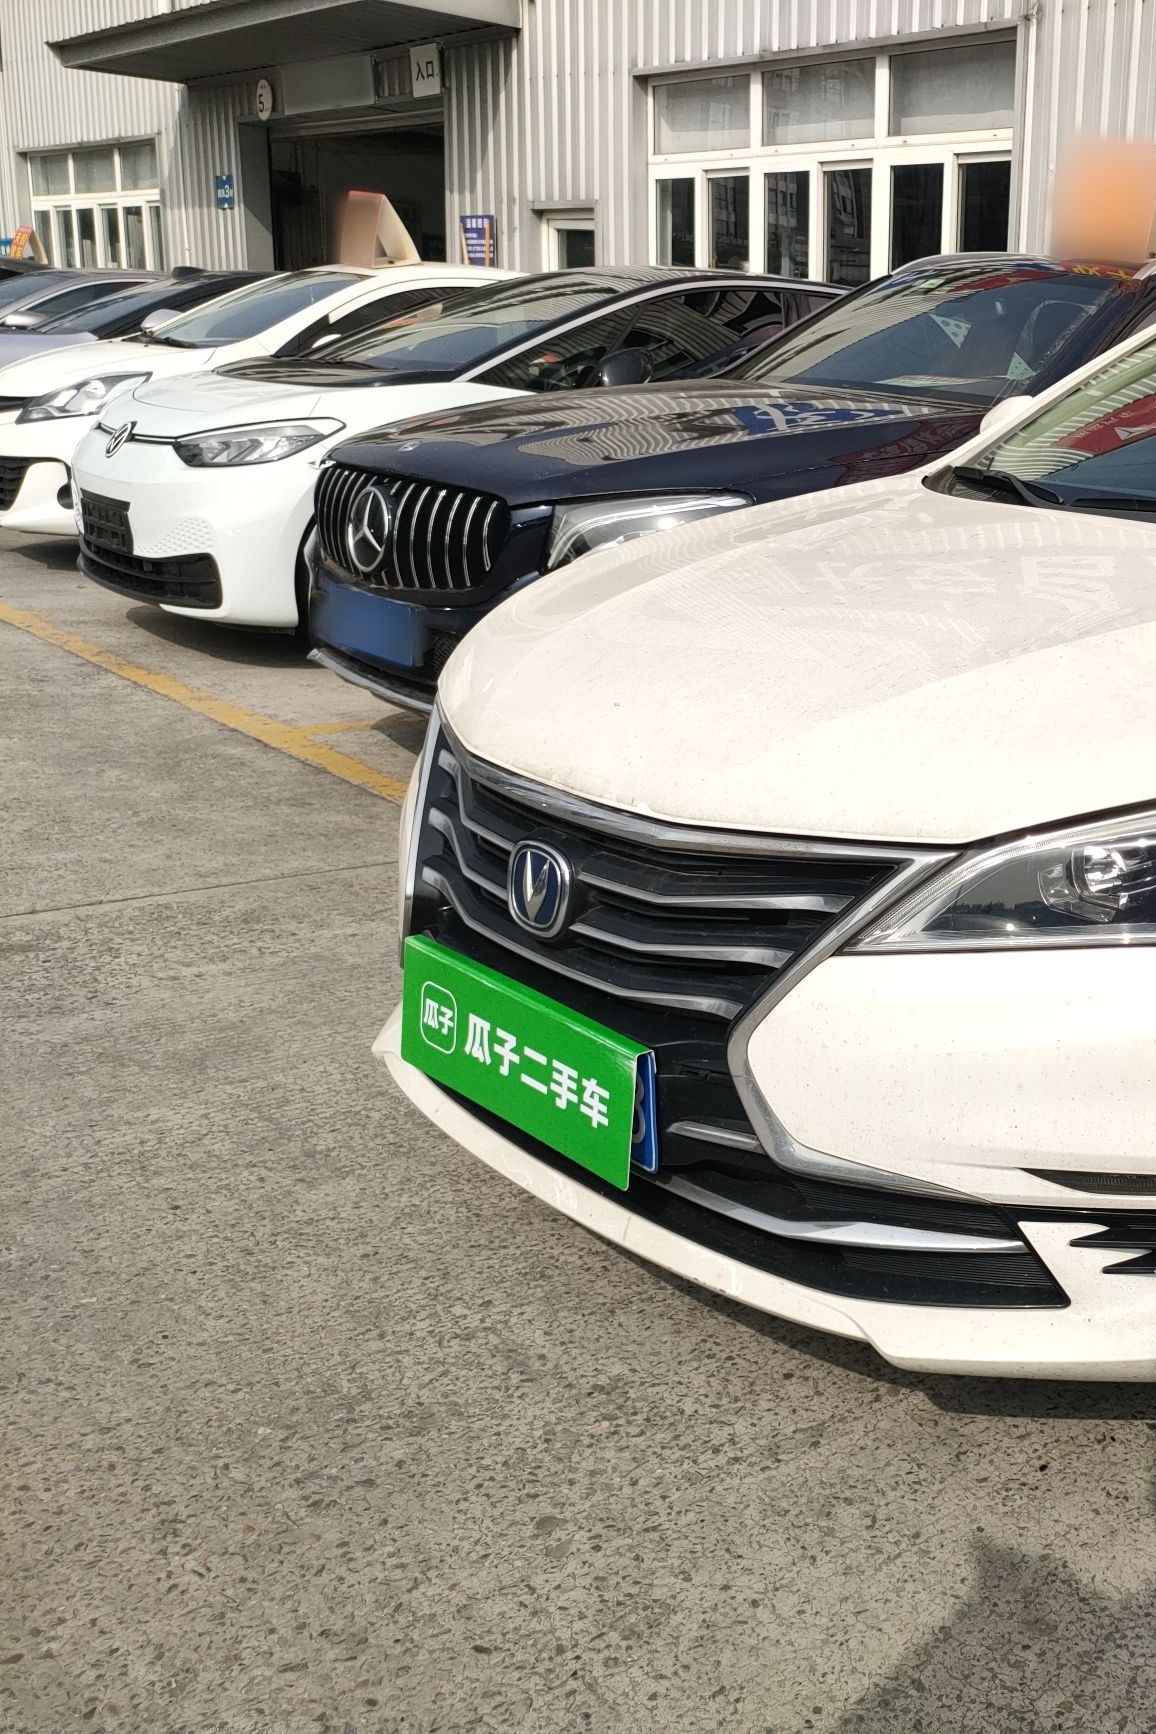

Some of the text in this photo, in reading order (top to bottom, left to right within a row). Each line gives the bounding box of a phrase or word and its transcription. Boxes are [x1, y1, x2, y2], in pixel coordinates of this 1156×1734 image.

[416, 60, 435, 81] 入口
[424, 998, 454, 1035] 瓜子
[464, 1012, 610, 1129] 瓜子二手车
